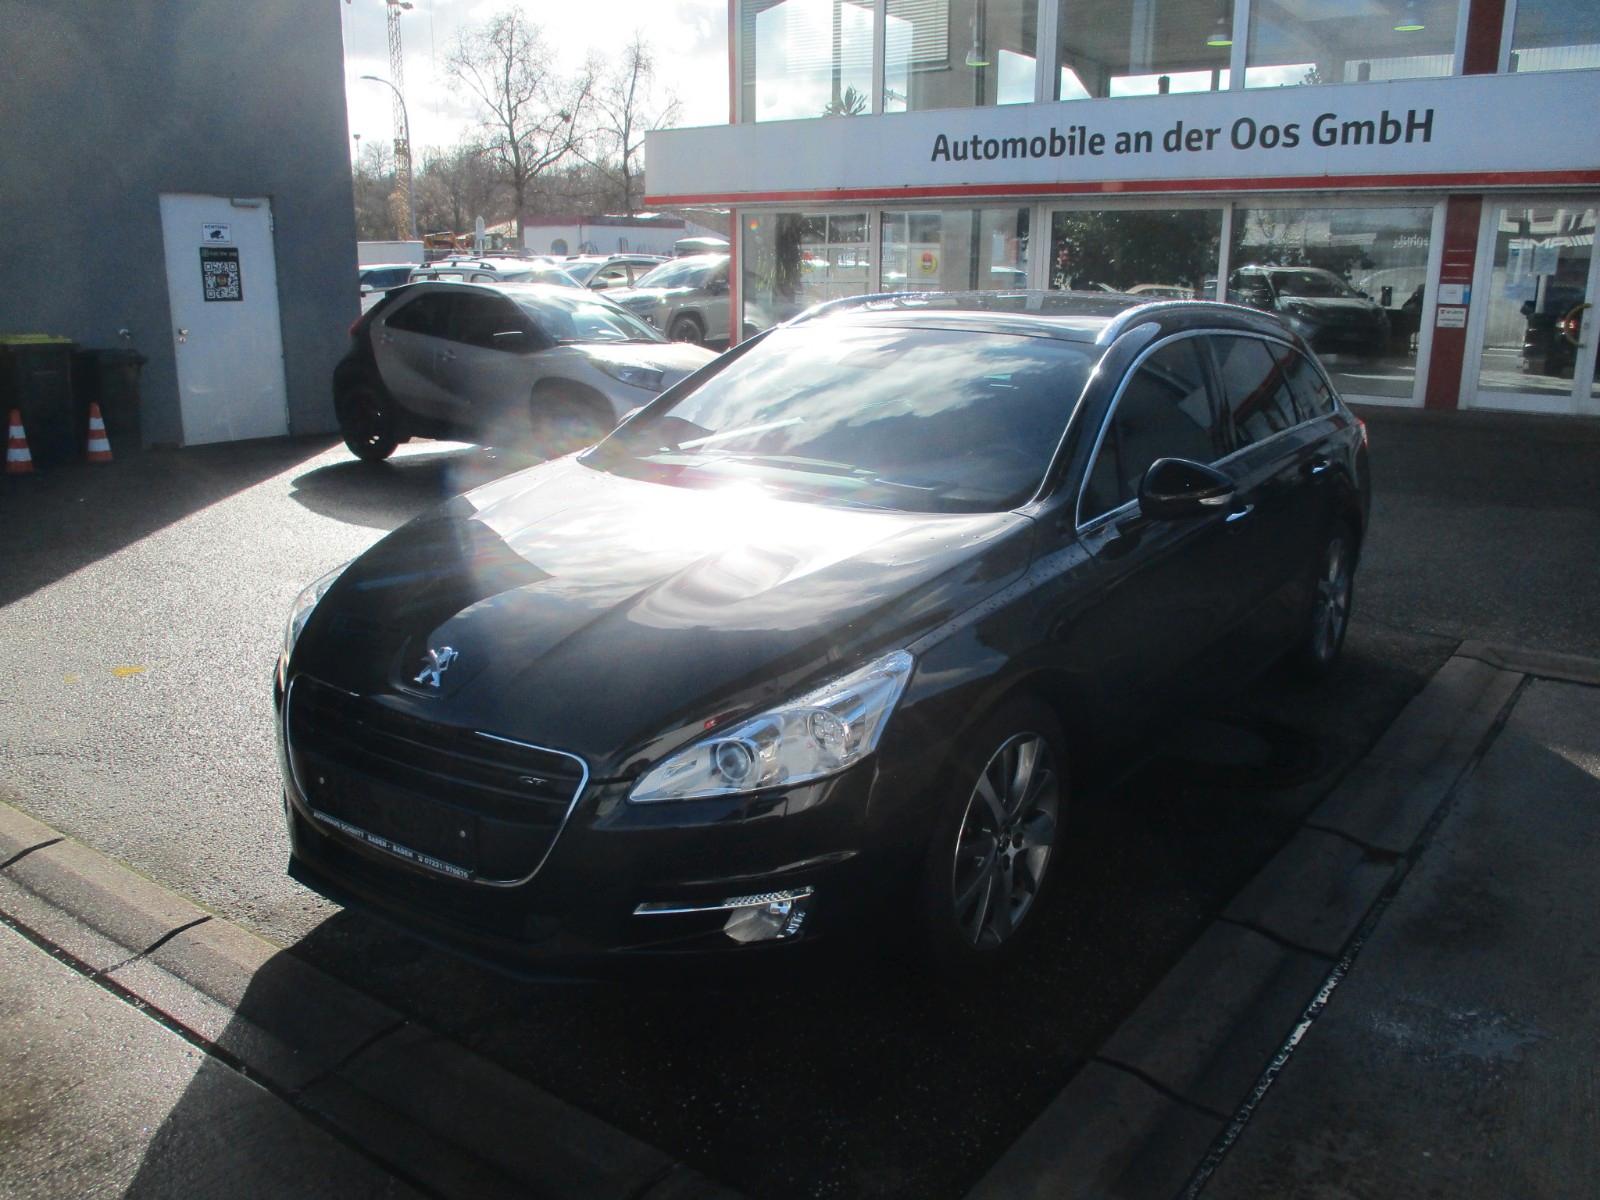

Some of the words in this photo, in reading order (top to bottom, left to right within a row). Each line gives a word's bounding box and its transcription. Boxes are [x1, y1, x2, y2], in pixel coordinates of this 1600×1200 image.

[931, 125, 1105, 162] Automobile
[1115, 130, 1153, 154] an
[1163, 120, 1221, 152] der
[1231, 116, 1300, 150] Oos
[1312, 108, 1434, 147] GmbH
